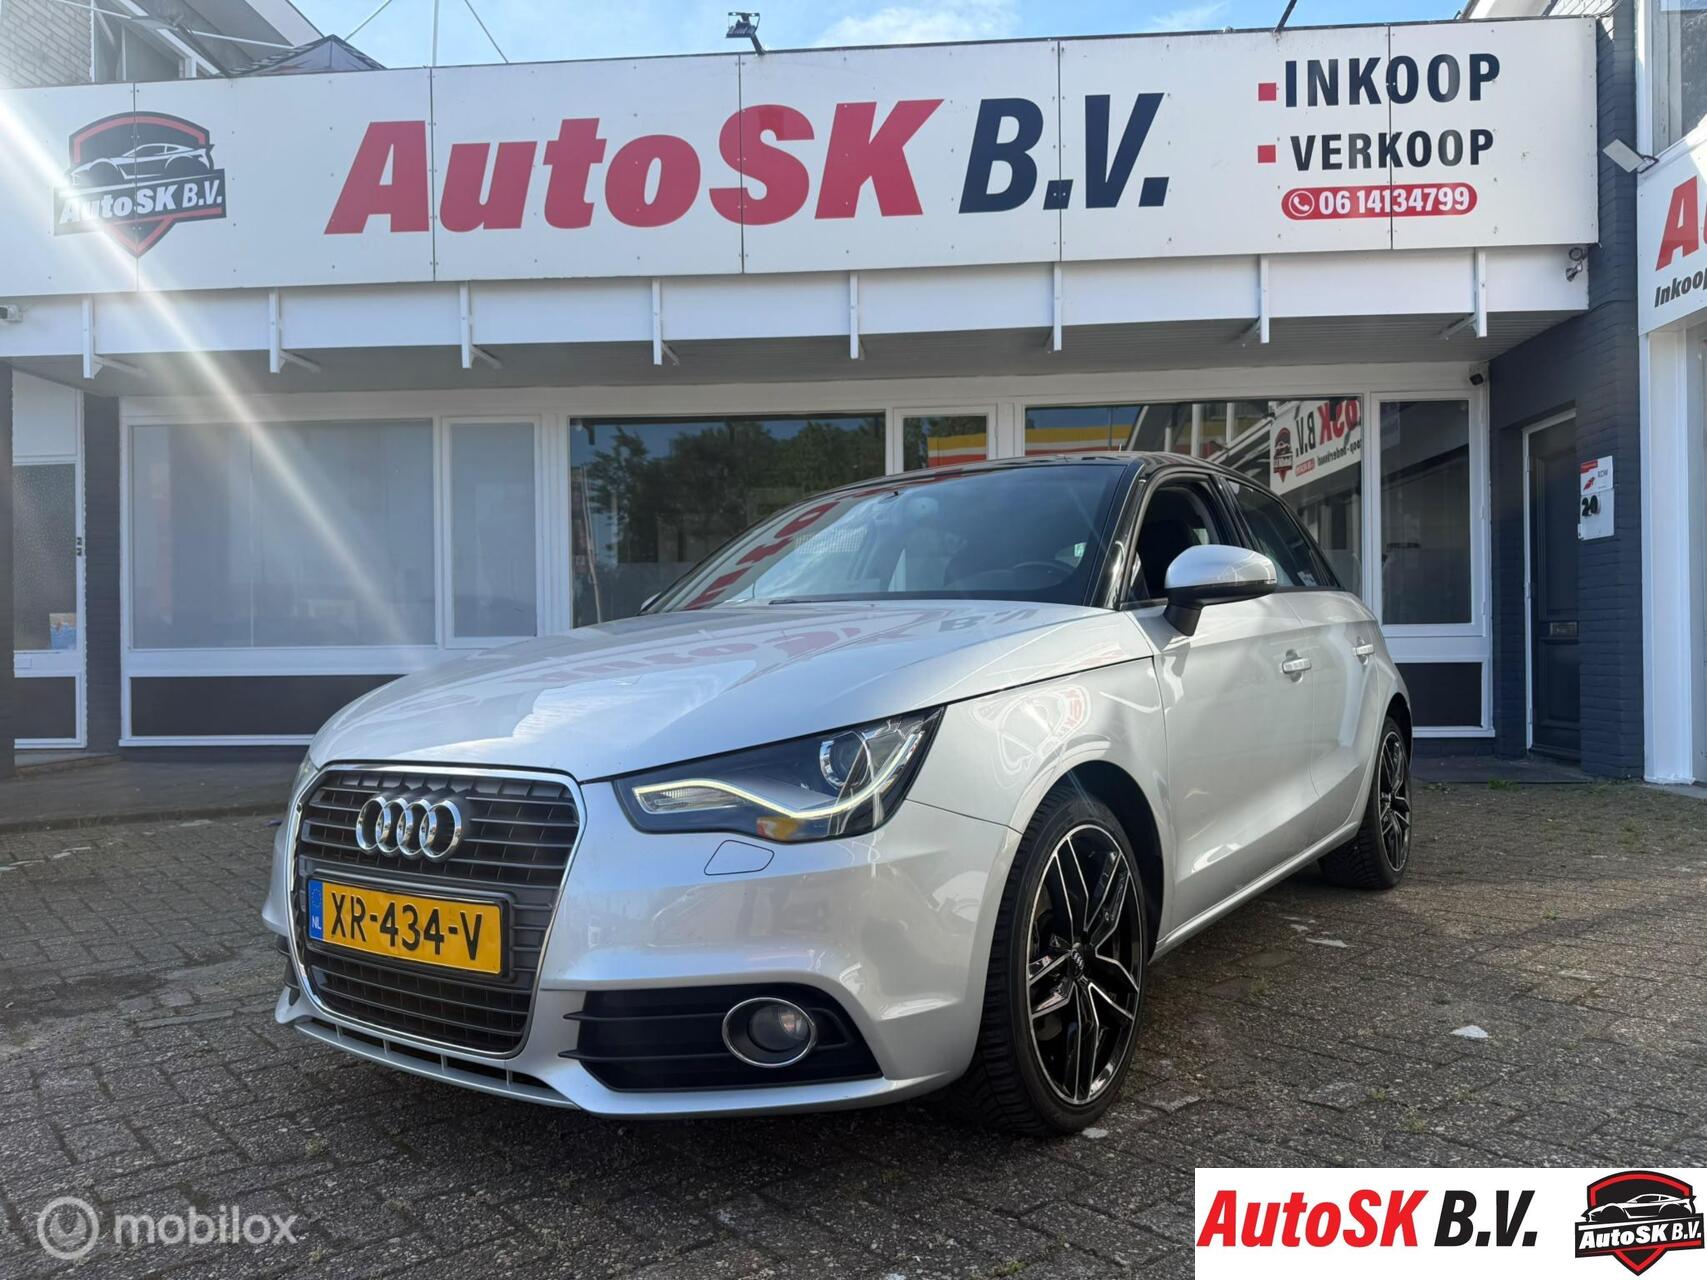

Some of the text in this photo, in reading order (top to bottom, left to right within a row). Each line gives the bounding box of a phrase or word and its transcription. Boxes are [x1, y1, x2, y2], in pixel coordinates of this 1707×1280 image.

[1285, 53, 1500, 108] INKOOP
[323, 92, 1170, 235] AutoSK B.V.
[1290, 128, 1494, 171] VERKOOP
[59, 180, 223, 225] AutoSK B.V.
[1319, 186, 1470, 215] 06 14134799
[1655, 175, 1707, 271] A
[311, 915, 322, 930] NL
[331, 891, 483, 961] XR-434-V
